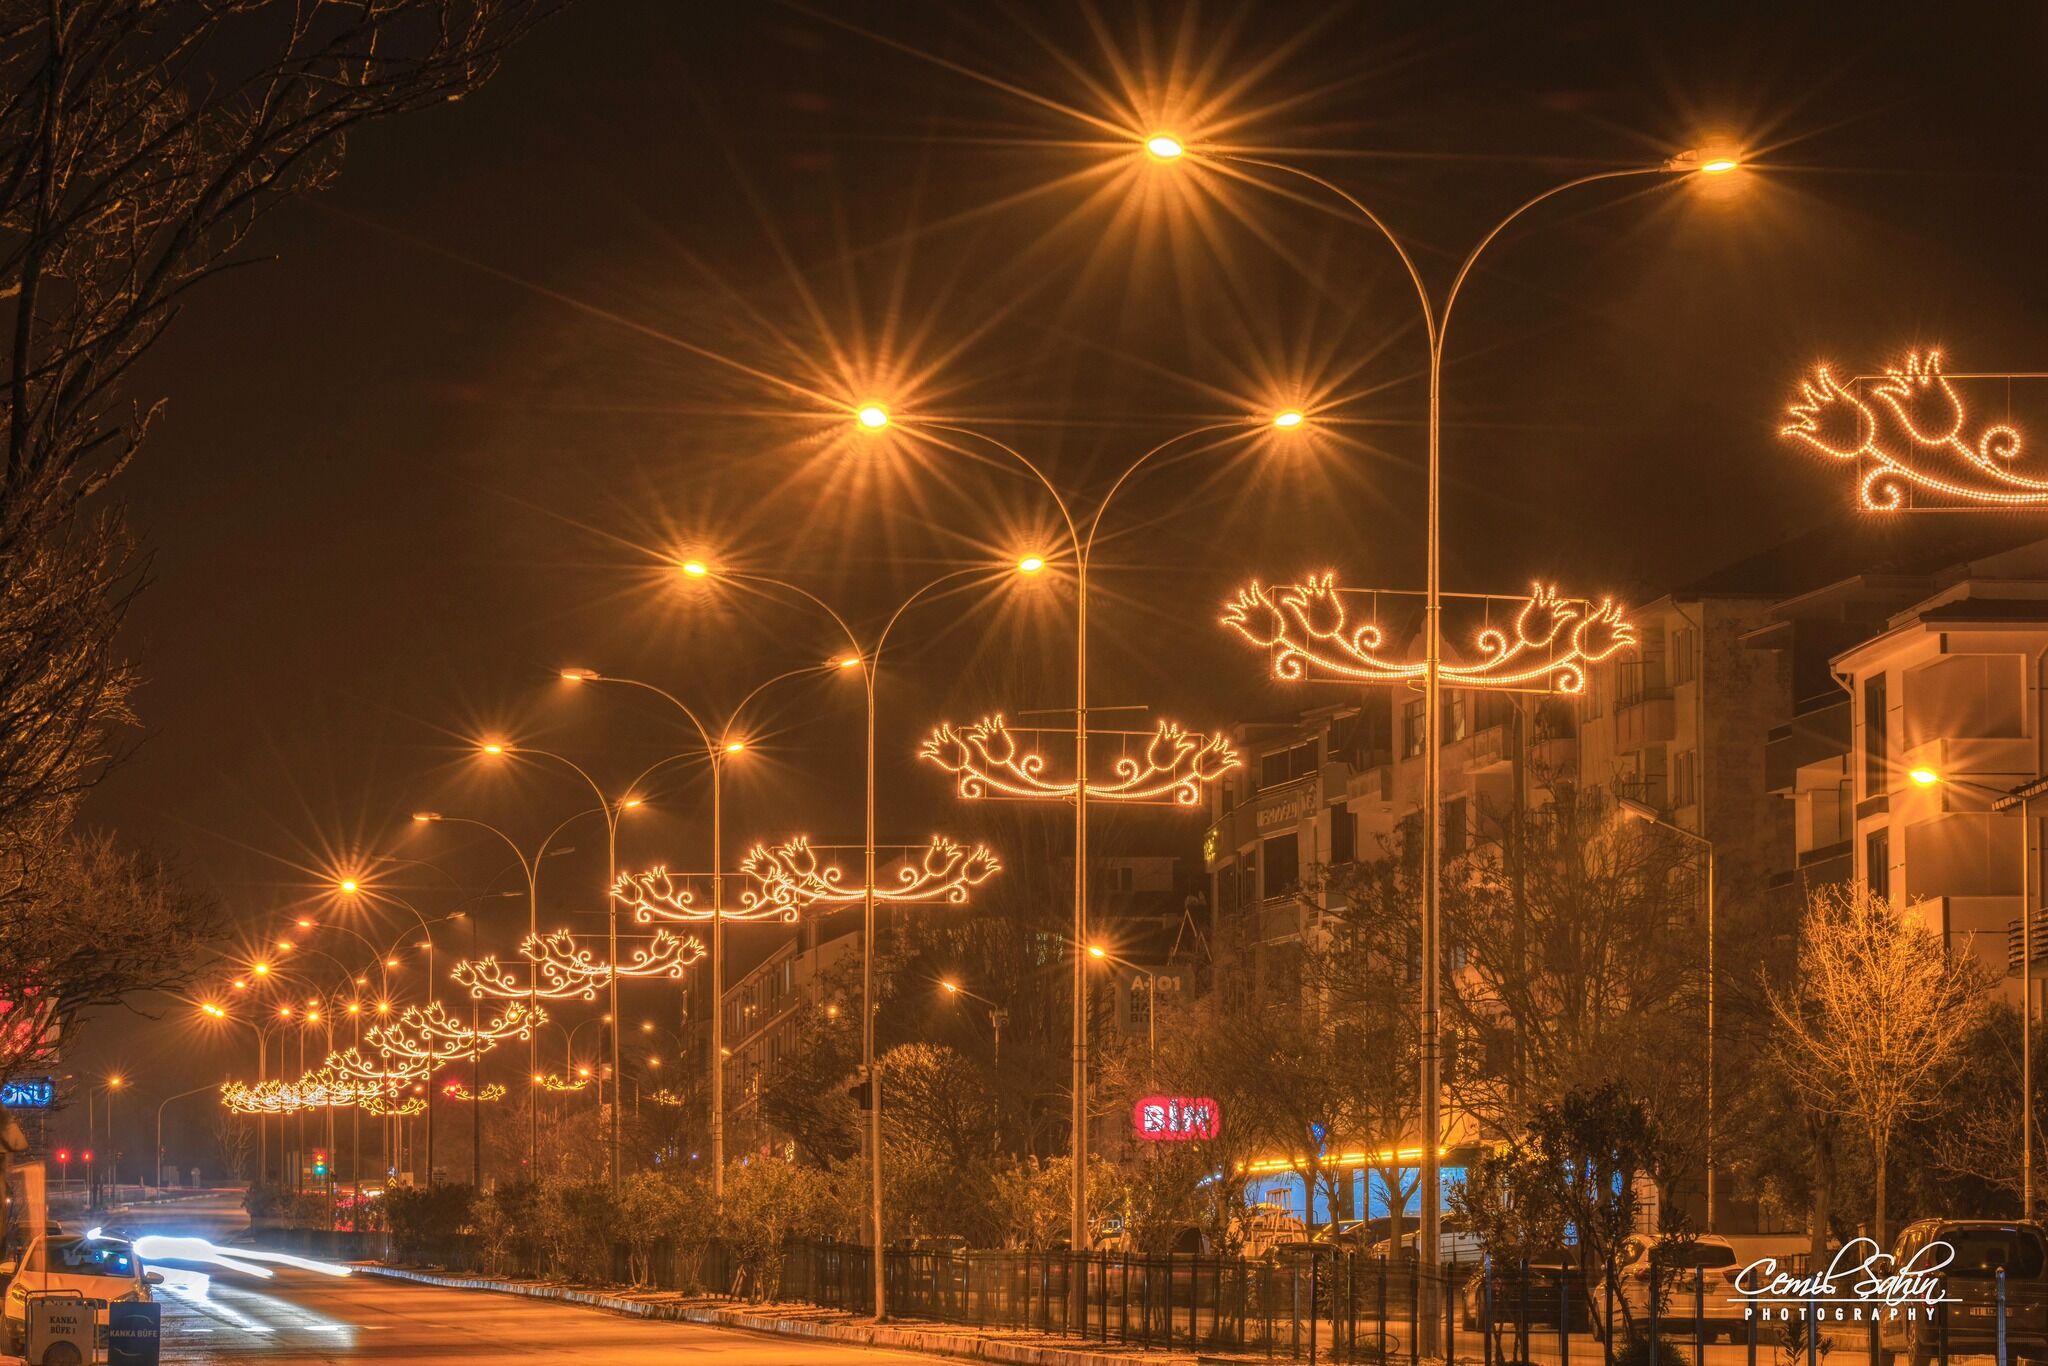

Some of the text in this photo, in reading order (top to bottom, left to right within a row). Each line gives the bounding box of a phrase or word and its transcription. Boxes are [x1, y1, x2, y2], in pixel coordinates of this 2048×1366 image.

[49, 1316, 78, 1324] KANKA
[50, 1324, 70, 1334] BÜFE
[110, 1328, 158, 1338] KANKA BÜFE
